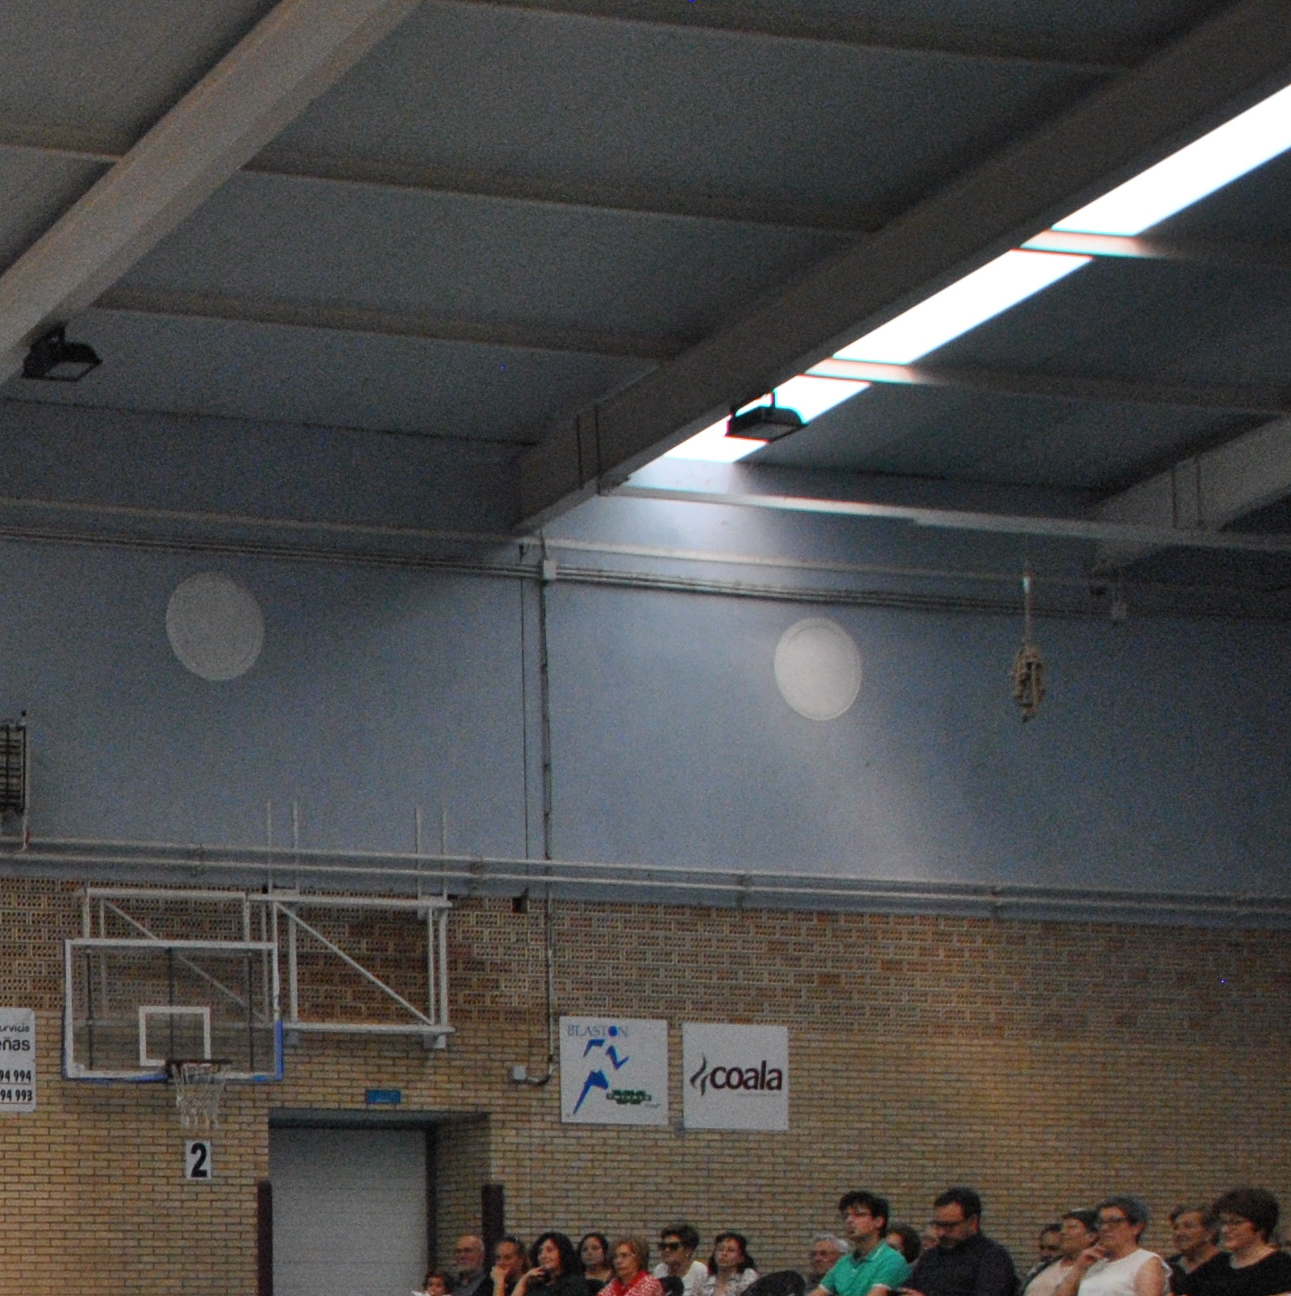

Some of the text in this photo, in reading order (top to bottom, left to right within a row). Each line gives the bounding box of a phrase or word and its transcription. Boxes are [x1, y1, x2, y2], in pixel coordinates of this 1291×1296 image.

[14, 1070, 31, 1082] 994
[710, 1060, 783, 1090] coala
[15, 1090, 33, 1102] 993
[190, 1142, 207, 1177] 2
